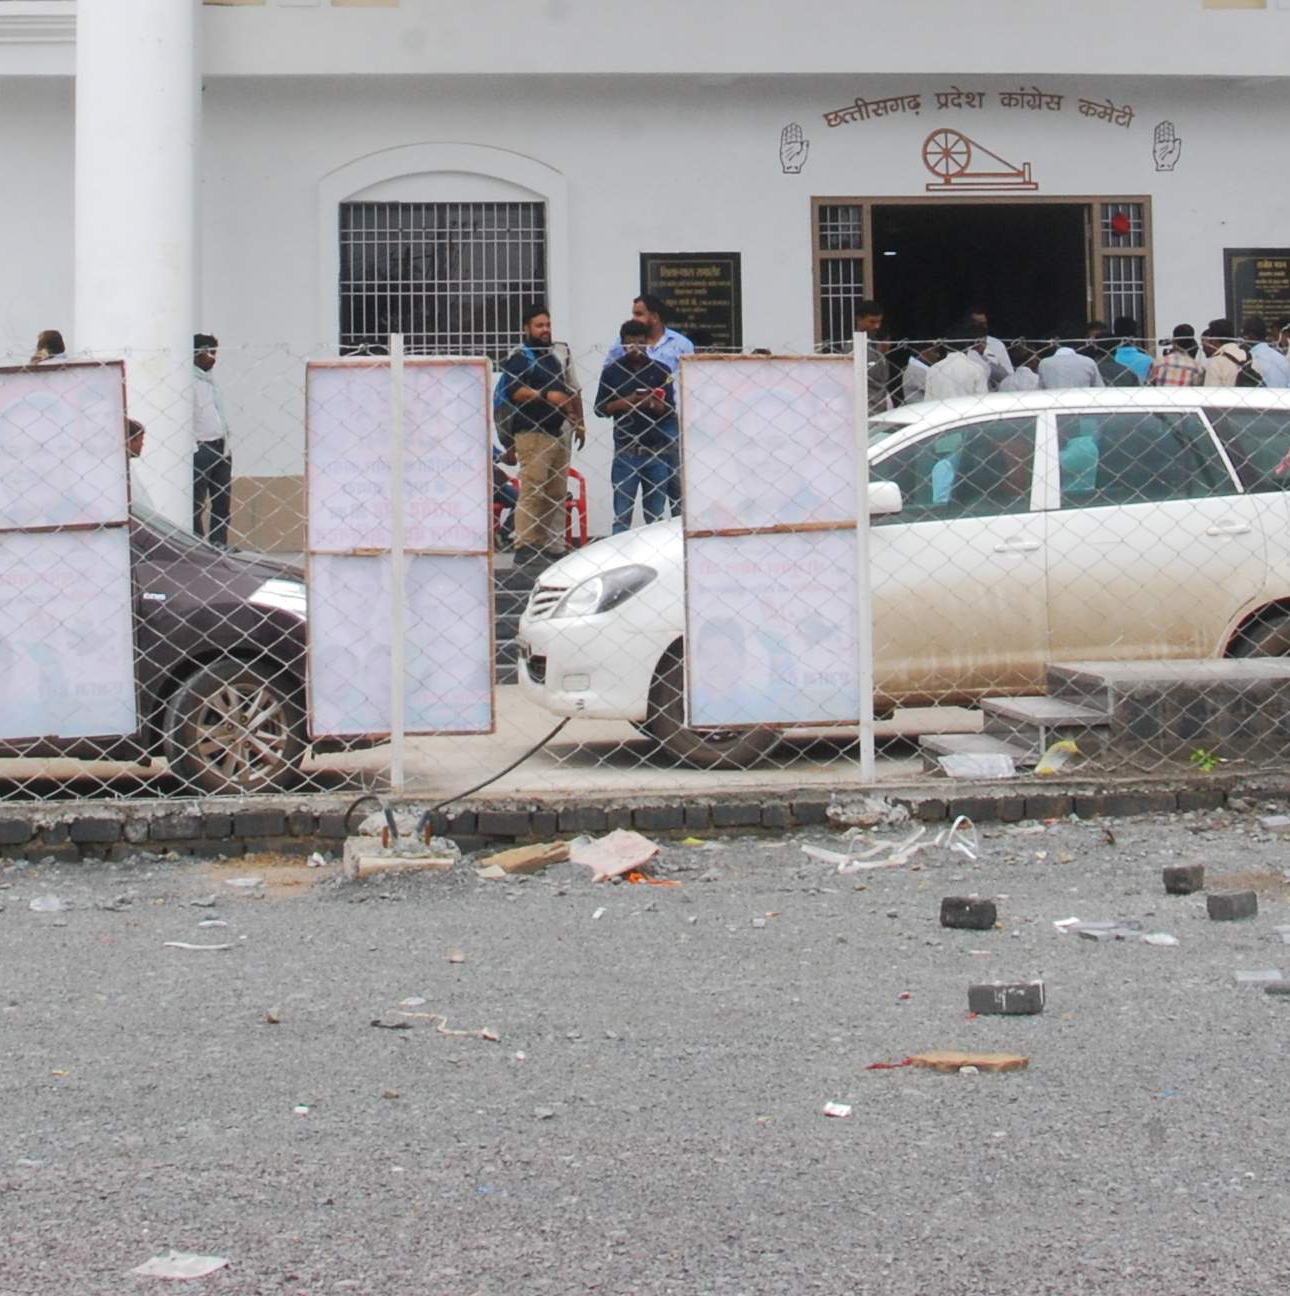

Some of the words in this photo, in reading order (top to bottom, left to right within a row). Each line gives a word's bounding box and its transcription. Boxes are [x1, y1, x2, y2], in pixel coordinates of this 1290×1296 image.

[822, 93, 921, 127] छत्तीसगढ़
[934, 85, 985, 110] प्रदेश
[998, 85, 1064, 111] कांग्रेस
[1078, 98, 1135, 128] कमेटी
